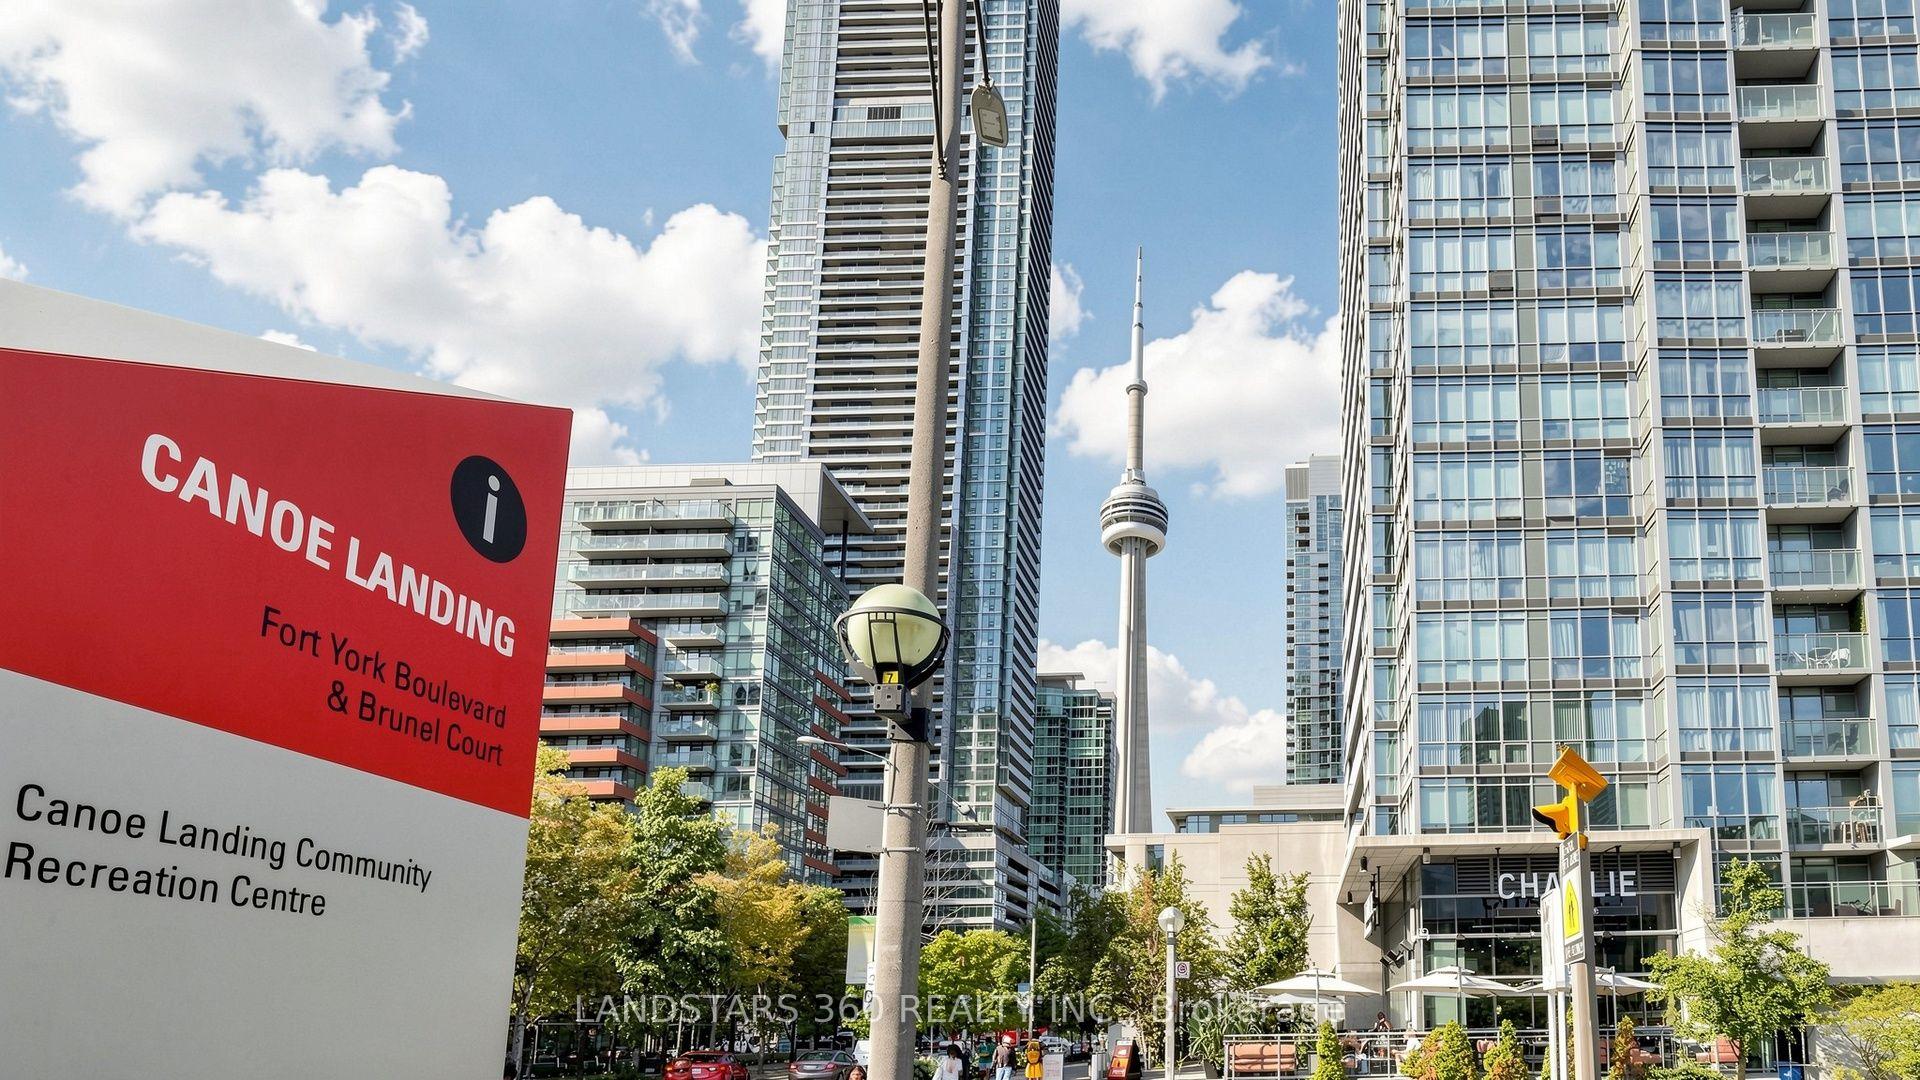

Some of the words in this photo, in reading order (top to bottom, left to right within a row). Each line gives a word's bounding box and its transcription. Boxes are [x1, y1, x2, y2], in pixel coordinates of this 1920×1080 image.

[141, 433, 335, 570] CANOE
[345, 536, 515, 657] LANDING
[261, 606, 321, 658] Fort
[331, 632, 386, 683] York
[395, 661, 507, 730] Boulevard
[886, 672, 894, 683] 7
[327, 679, 349, 714] &
[358, 692, 440, 746] Brunel
[446, 731, 504, 767] Court
[4, 842, 218, 903] Recreation
[230, 875, 326, 917] Centre
[16, 783, 146, 839] Canoe
[159, 810, 286, 869] Landing
[295, 837, 432, 893] Community
[1498, 870, 1636, 899] CHALIE
